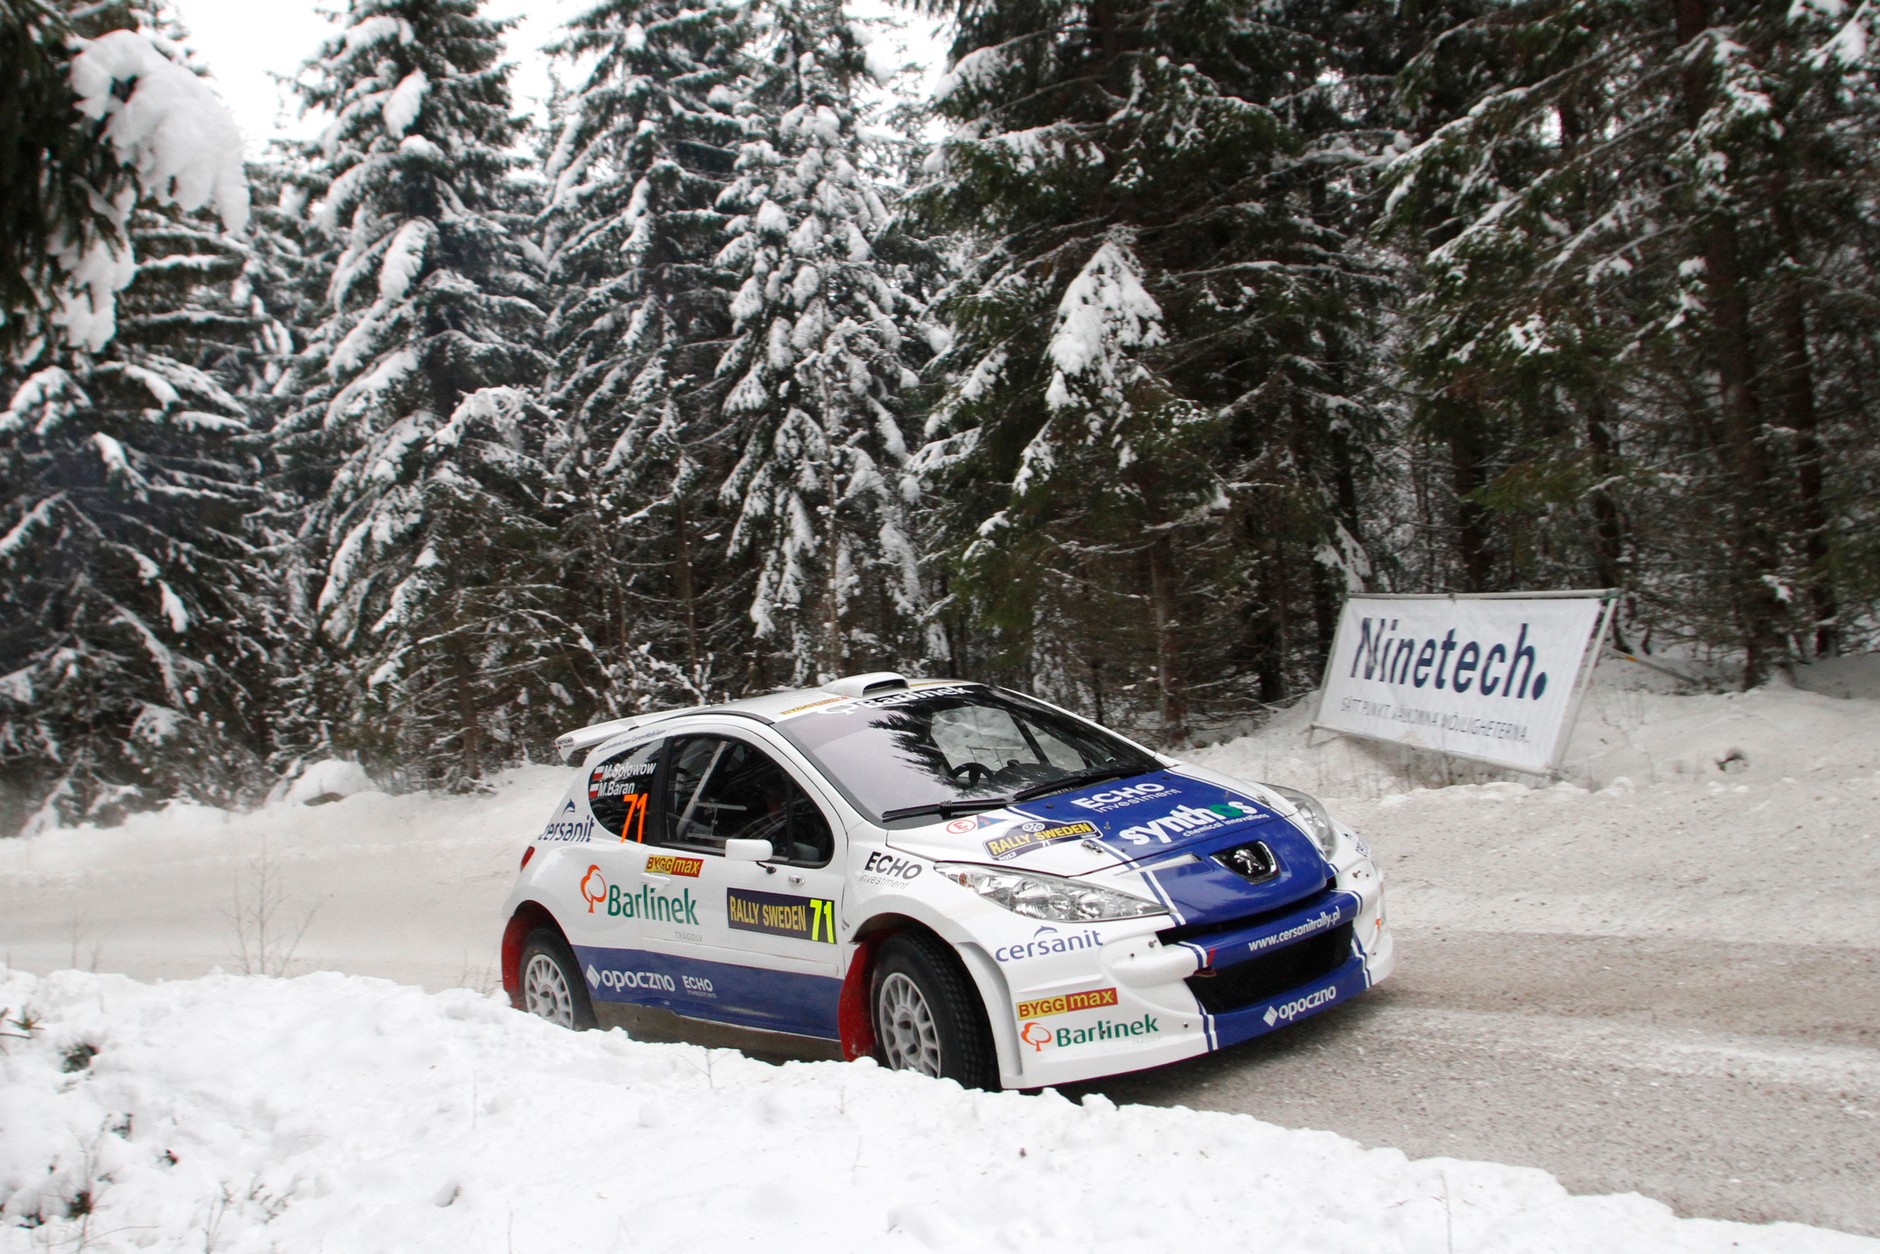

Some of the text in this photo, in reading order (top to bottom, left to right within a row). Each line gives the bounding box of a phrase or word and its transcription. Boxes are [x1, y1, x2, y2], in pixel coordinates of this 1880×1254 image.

[857, 686, 974, 709] Barlinek
[1070, 783, 1165, 809] ECHO
[1092, 788, 1182, 813] investment
[620, 793, 648, 844] 71
[1119, 801, 1258, 845] synthos
[1182, 821, 1224, 837] chemical
[988, 823, 1092, 855] RALLY SWEDEN
[862, 875, 908, 888] investment
[864, 851, 923, 880] ECHO
[608, 884, 700, 925] Barlinek
[729, 895, 835, 944] RALLY SWEDEN 71
[1248, 905, 1341, 952] www.cersanitrally.pl
[995, 930, 1104, 962] cersanit
[601, 969, 676, 992] opoczno
[682, 975, 713, 992] ECHO
[1278, 985, 1337, 1021] opoczno
[1056, 1014, 1159, 1047] Barlinek
